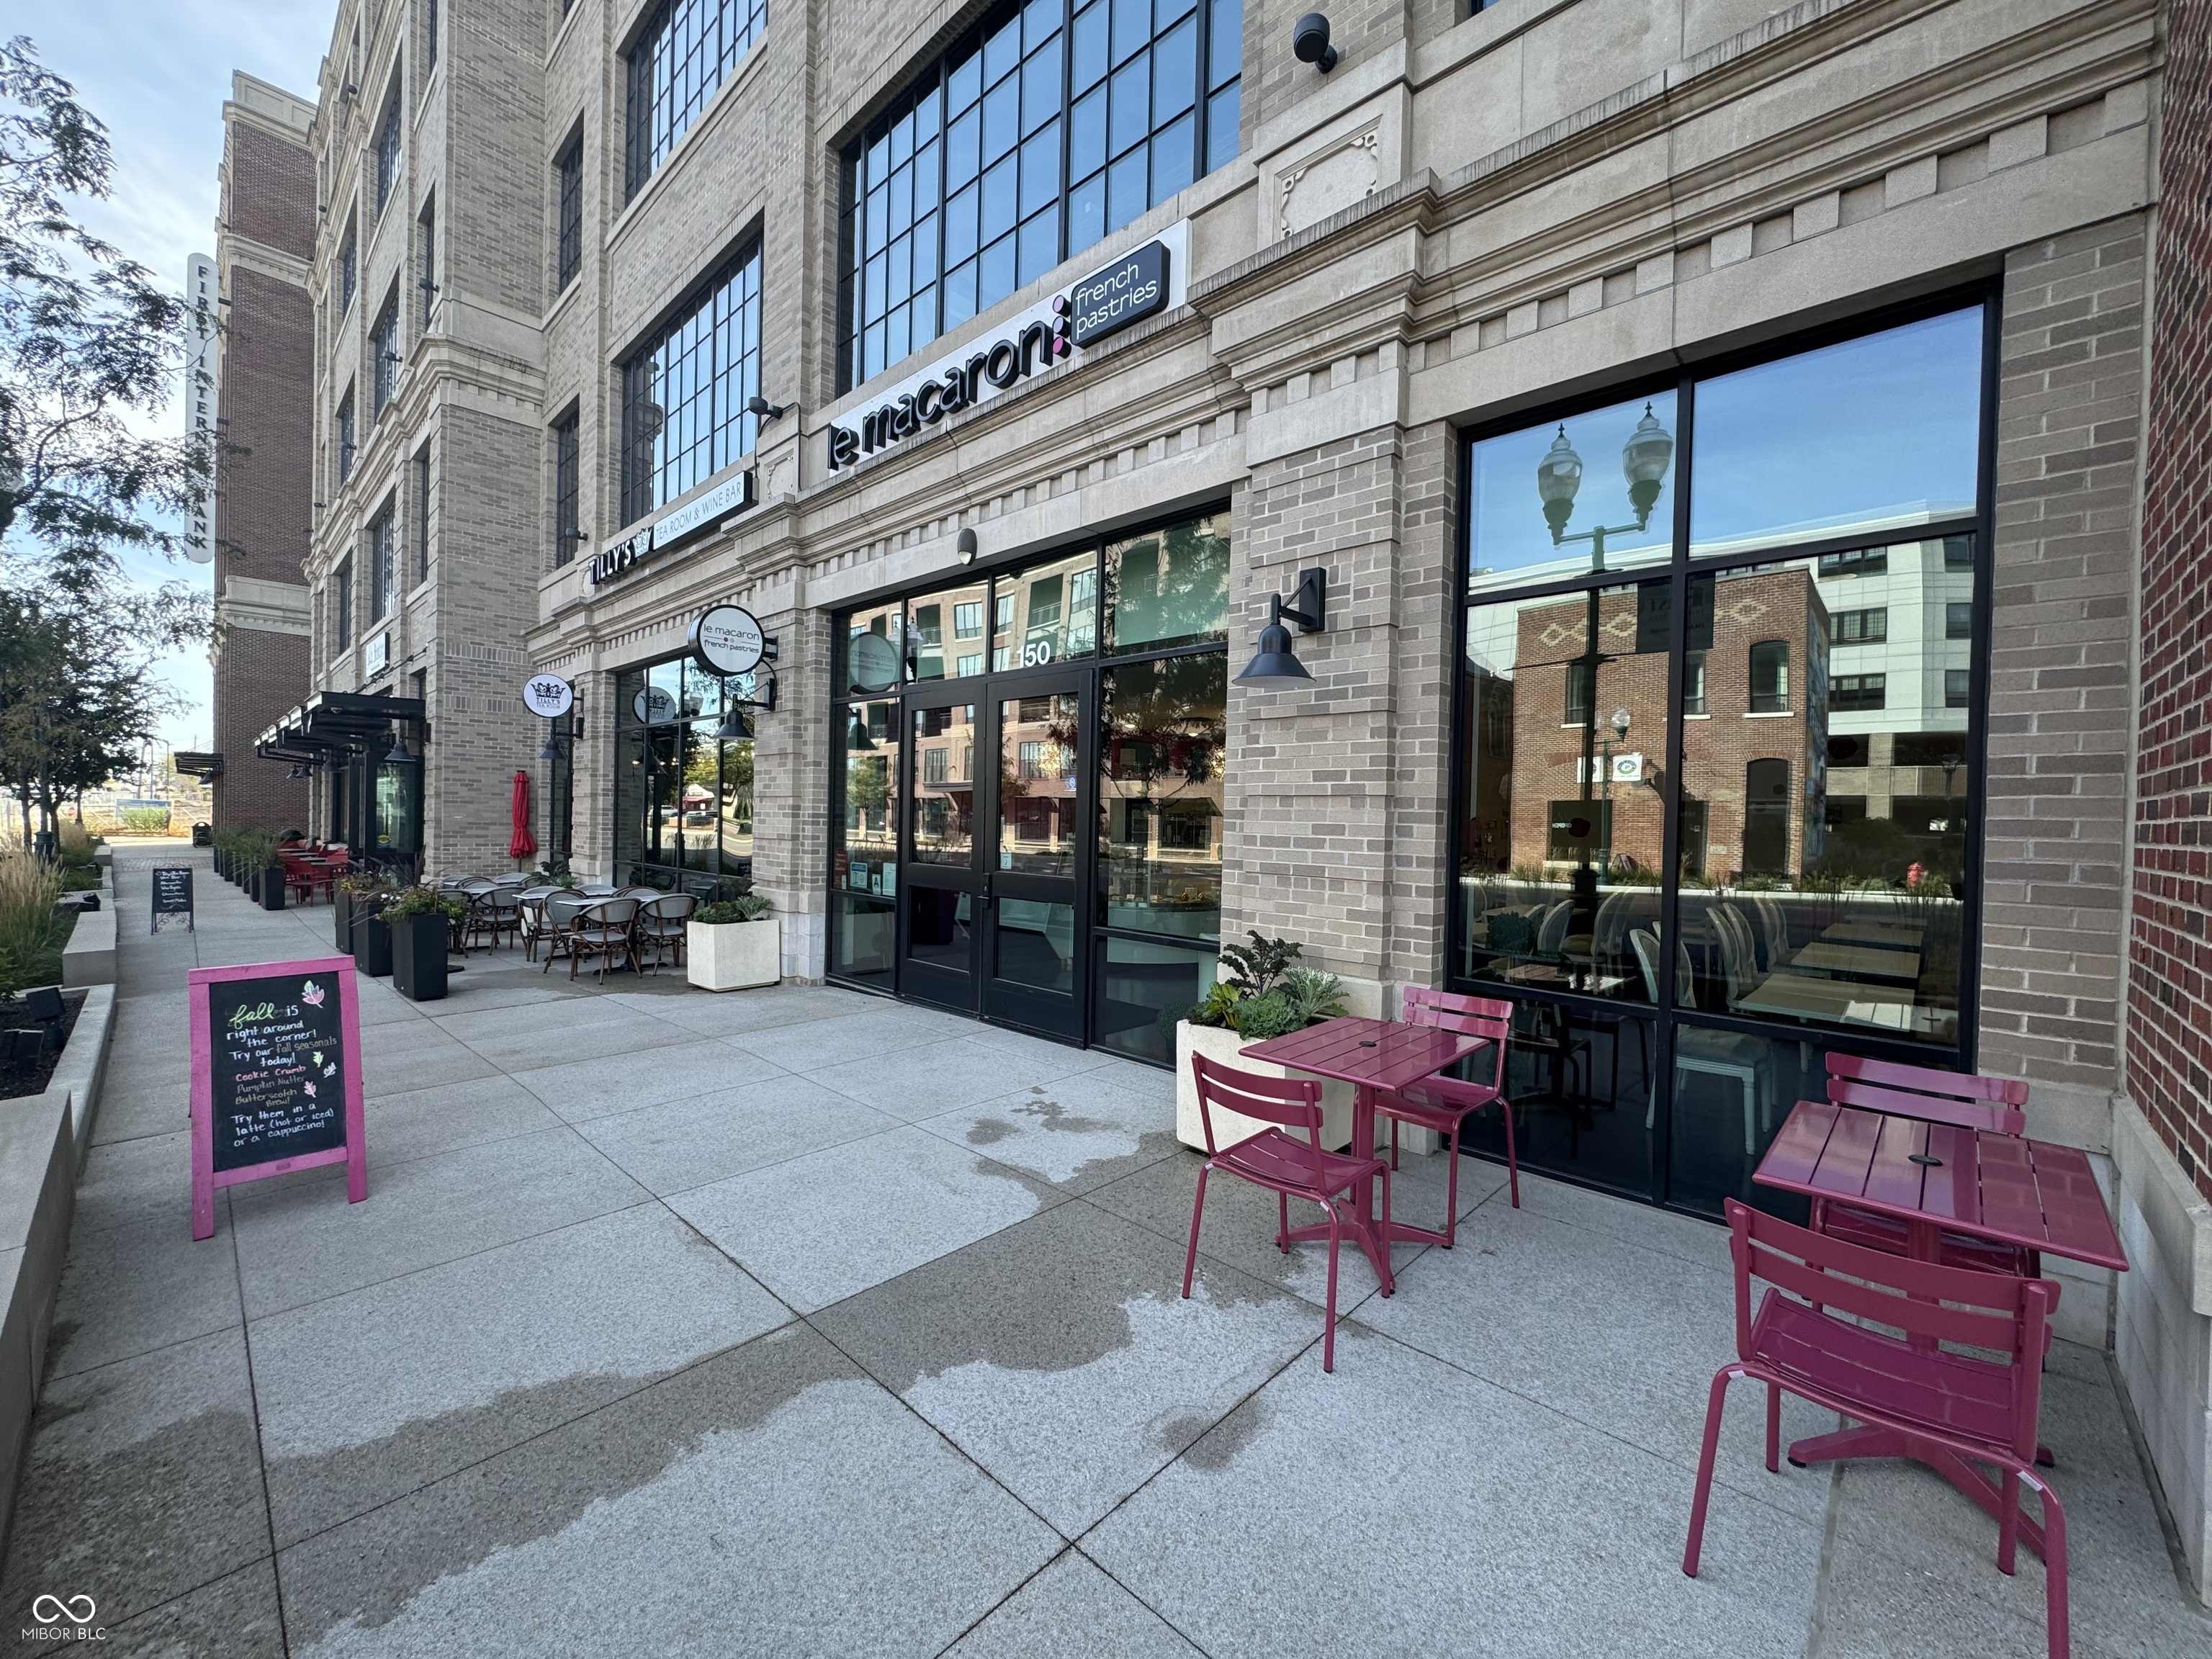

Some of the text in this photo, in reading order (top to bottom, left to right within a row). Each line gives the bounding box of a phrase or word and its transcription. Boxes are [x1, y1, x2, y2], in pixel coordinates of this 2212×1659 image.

[197, 264, 210, 340] FIRST
[1076, 263, 1139, 315] french
[1076, 279, 1157, 341] pastries
[827, 319, 1053, 471] le macaron
[655, 481, 742, 541] TEA ROOM & WINE BAR
[589, 539, 634, 584] TILLY'S
[703, 624, 760, 641] le macaron
[703, 639, 760, 654] french pastries
[1016, 641, 1051, 669] 150
[229, 1002, 299, 1029] fall is
[227, 1020, 304, 1042] right around
[247, 1028, 317, 1048] the corner!
[229, 1035, 337, 1062] Try our fall seasonals
[260, 1051, 296, 1067] today!
[235, 1065, 307, 1082] Cookie Crumb
[237, 1074, 307, 1094] Pumpkin Nutter
[230, 1114, 253, 1124] Try
[258, 1110, 284, 1120] them
[292, 1105, 303, 1113] in
[266, 1097, 290, 1107] Brew!
[233, 1137, 248, 1147] or
[267, 1120, 325, 1138] cappuccino!
[235, 1123, 266, 1136] latte
[270, 1118, 292, 1128] (hot
[312, 1107, 335, 1120] iced)
